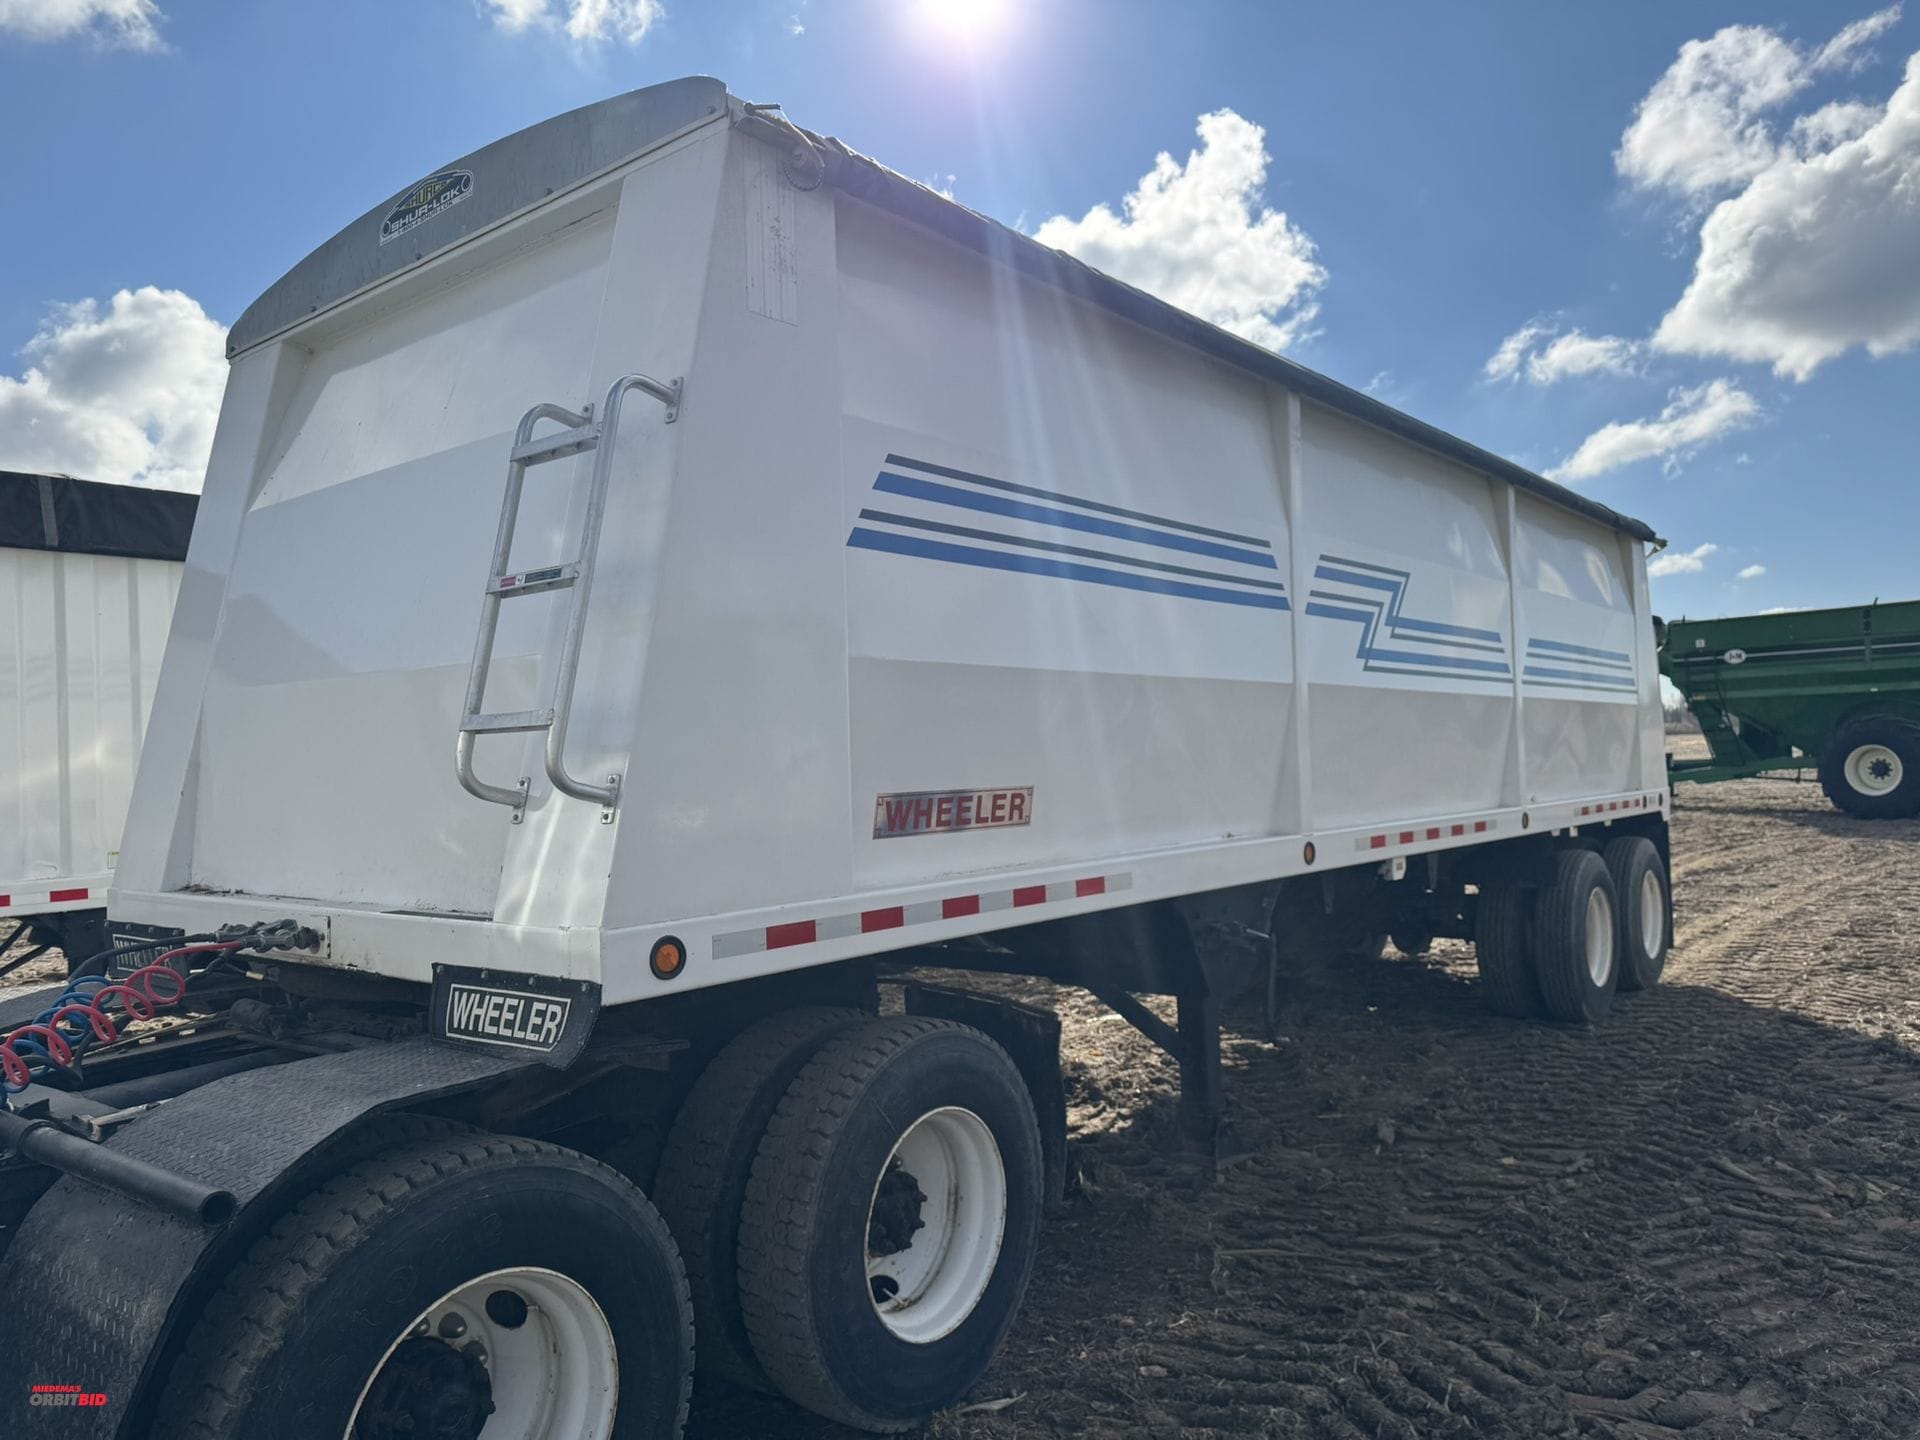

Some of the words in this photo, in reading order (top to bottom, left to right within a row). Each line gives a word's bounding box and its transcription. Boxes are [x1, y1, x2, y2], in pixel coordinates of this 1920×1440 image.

[391, 185, 460, 232] SHUR-LOK
[885, 792, 1026, 832] WHEELER
[453, 990, 563, 1044] WHEELER
